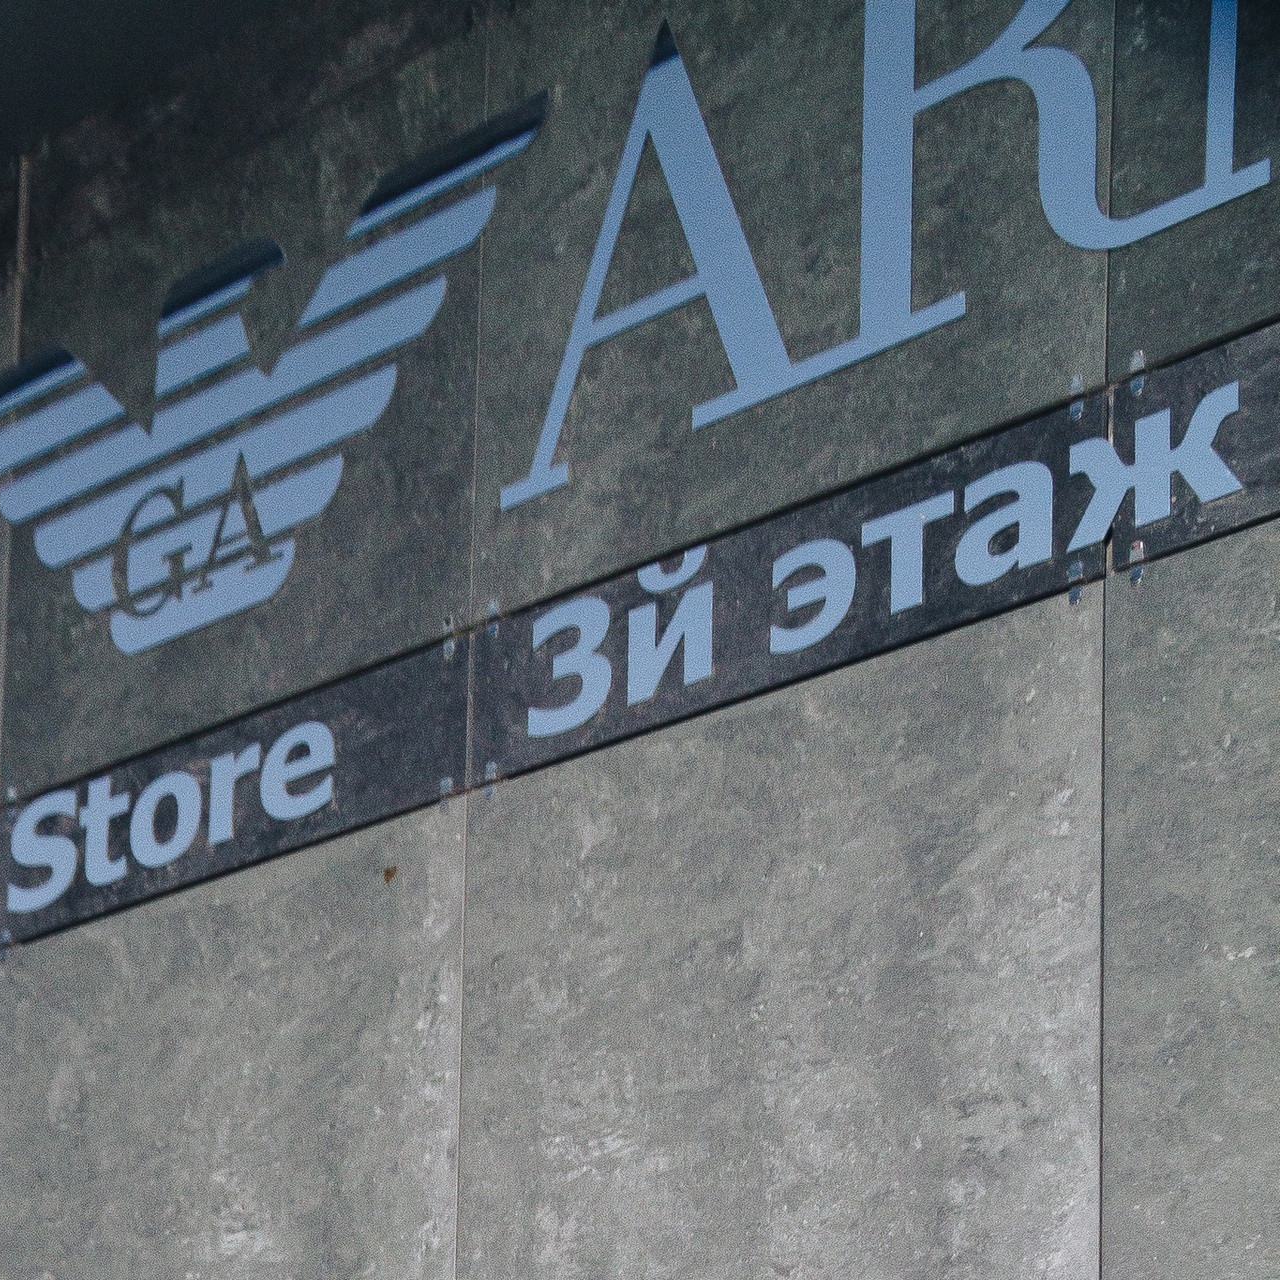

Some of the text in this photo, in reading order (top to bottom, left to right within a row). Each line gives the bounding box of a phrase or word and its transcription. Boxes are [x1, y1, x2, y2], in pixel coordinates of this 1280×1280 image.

[499, 0, 1273, 511] AR
[112, 450, 283, 618] GA
[769, 381, 1243, 654] этаж
[6, 720, 336, 915] Store
